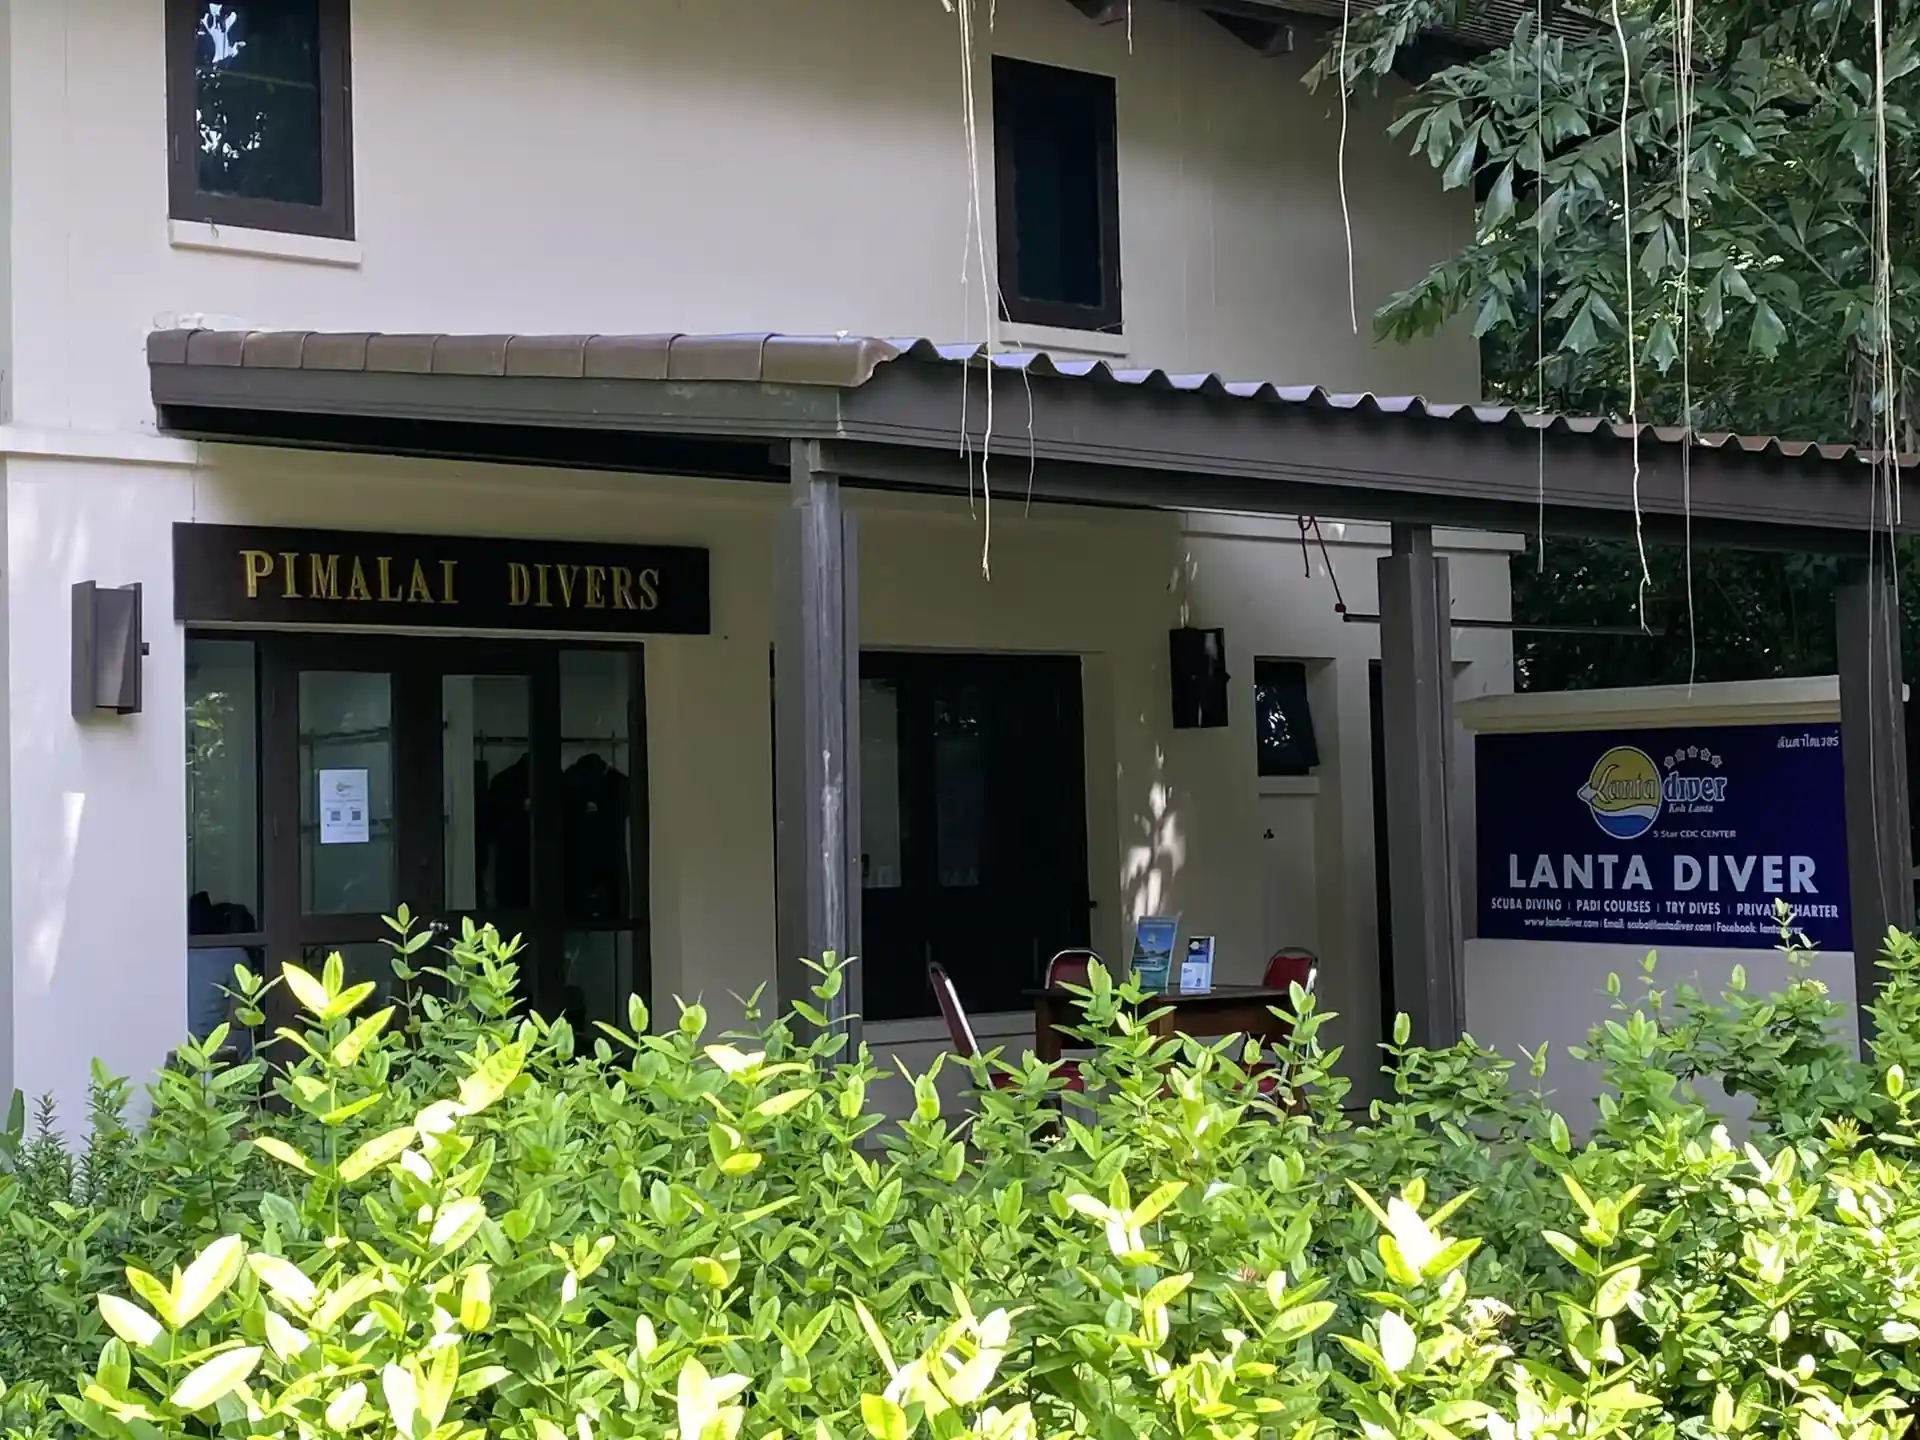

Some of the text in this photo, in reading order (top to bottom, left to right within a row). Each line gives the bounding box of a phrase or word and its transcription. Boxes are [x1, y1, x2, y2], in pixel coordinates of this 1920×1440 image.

[239, 549, 660, 610] PIMALAI DIVERS
[1662, 771, 1728, 802] diver
[1668, 803, 1714, 814] Koh Lanta
[1660, 829, 1678, 839] Star
[1679, 830, 1699, 839] CDC
[1700, 830, 1737, 839] CENTER
[1509, 853, 1819, 894] LANTA DIVER
[1491, 897, 1839, 918] SCUBA DIVING PADI COURSES TRY DIVES PRIVAT CHARTER
[1524, 917, 1599, 929] www.lantadiver.com
